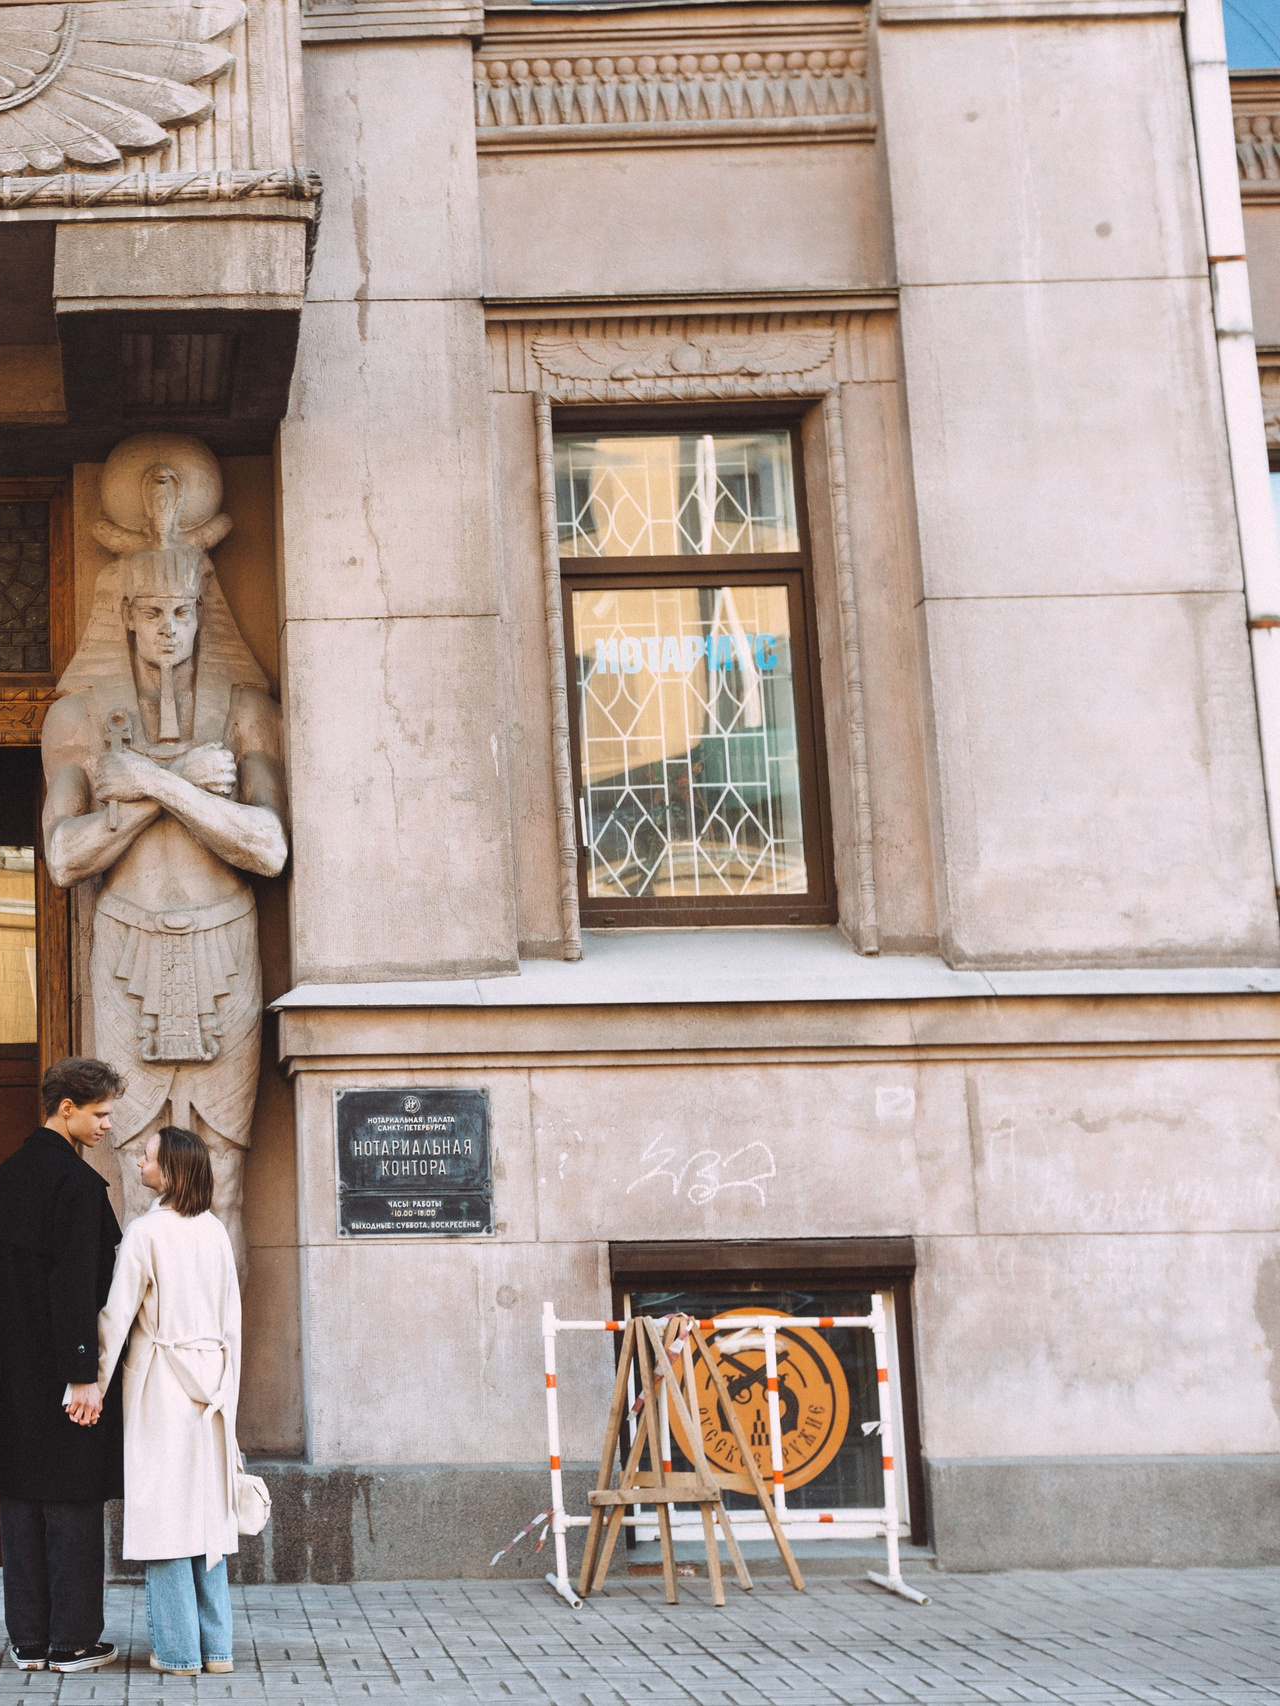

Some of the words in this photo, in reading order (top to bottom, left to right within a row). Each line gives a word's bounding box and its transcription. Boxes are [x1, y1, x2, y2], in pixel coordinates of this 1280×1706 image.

[595, 633, 778, 675] НОТАРИУС
[353, 1139, 472, 1156] НОТАРИАЛЬНАЯ
[381, 1159, 447, 1176] КОНТОРА
[388, 1200, 409, 1208] ЧАСЫ
[412, 1200, 442, 1208] РАБОТЫ
[351, 1222, 395, 1230] ВЫХОДНЫЕ:
[431, 1221, 481, 1229] ВОСКРЕСЕНЬЕ
[770, 1404, 825, 1465] РУЖИЕ
